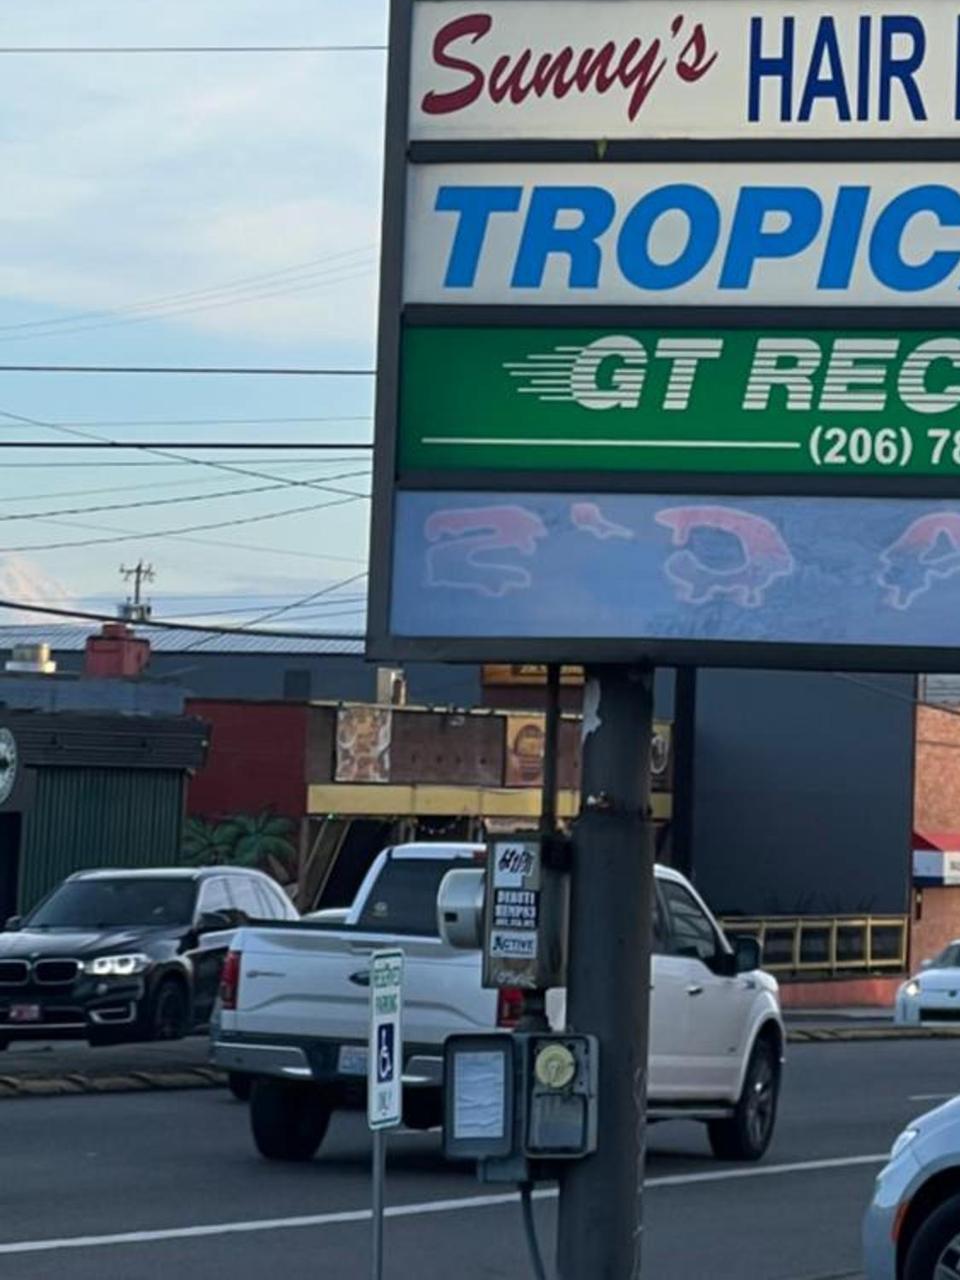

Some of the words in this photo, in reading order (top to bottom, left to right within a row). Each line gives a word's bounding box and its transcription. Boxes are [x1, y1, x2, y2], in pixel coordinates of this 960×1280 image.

[421, 13, 718, 122] Sunny's
[747, 15, 928, 122] HAIR
[569, 335, 724, 410] GT
[808, 426, 912, 468] (206)
